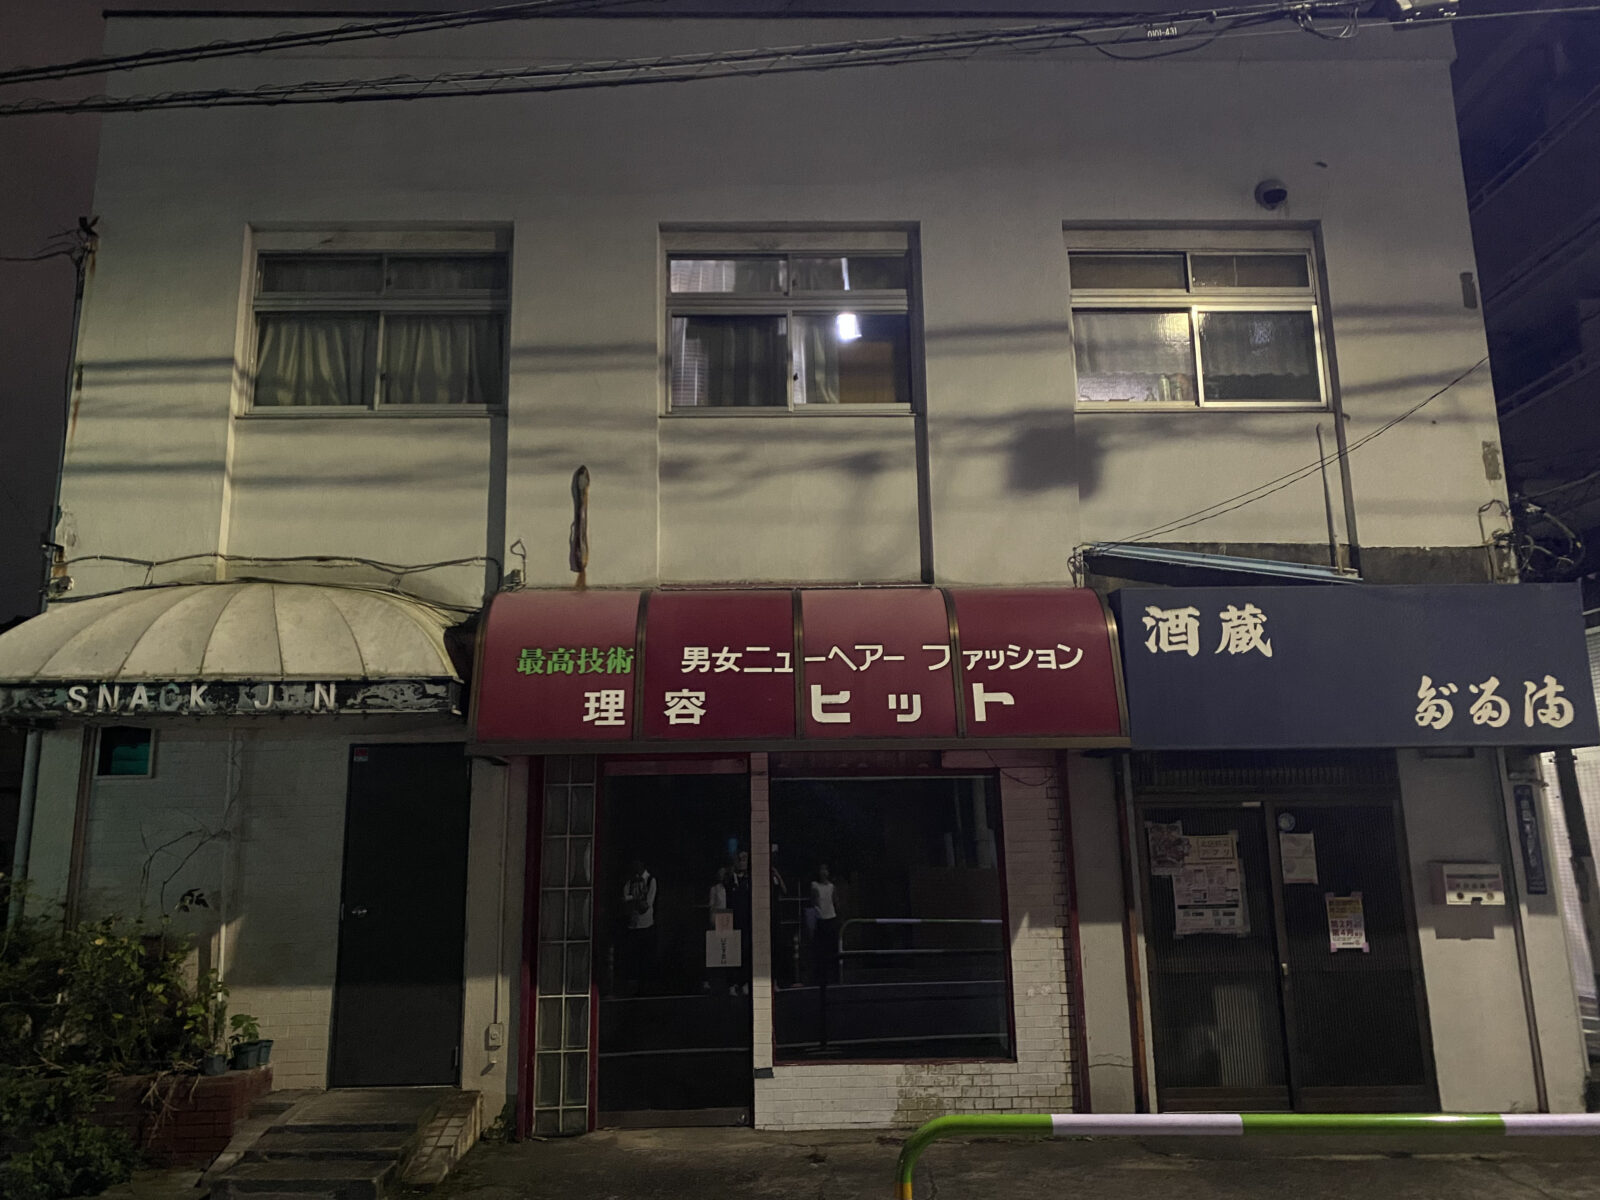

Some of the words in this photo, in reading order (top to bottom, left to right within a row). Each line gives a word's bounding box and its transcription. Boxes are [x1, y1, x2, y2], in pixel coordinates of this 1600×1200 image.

[1143, 603, 1274, 658] 酒蔵
[516, 646, 635, 676] 最高技術
[66, 684, 216, 713] SNACK
[582, 688, 707, 727] 理容
[809, 681, 1015, 724] ヒット
